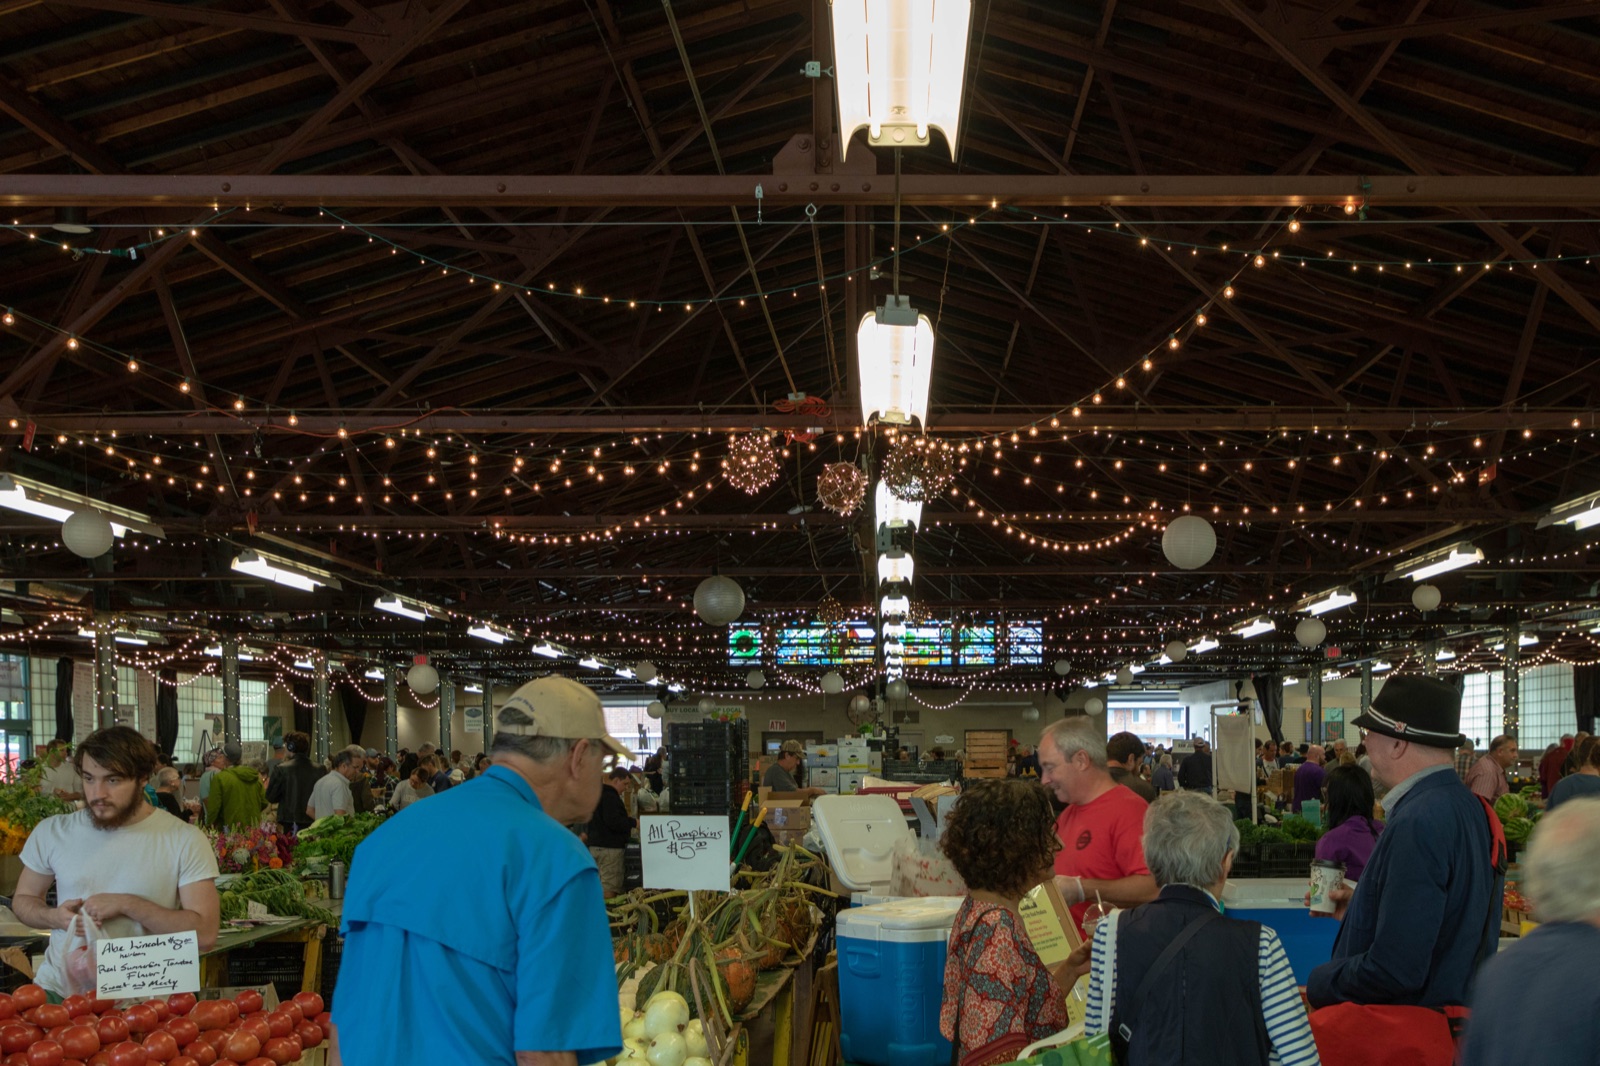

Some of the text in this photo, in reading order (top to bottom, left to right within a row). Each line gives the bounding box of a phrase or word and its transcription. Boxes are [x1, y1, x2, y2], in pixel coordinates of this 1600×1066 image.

[770, 721, 785, 730] ATM
[648, 820, 723, 842] All Pumpkins
[102, 942, 125, 955] Abe
[130, 937, 166, 950] Lincoln
[98, 964, 116, 974] Real
[101, 982, 130, 992] Sweet
[132, 981, 146, 989] and
